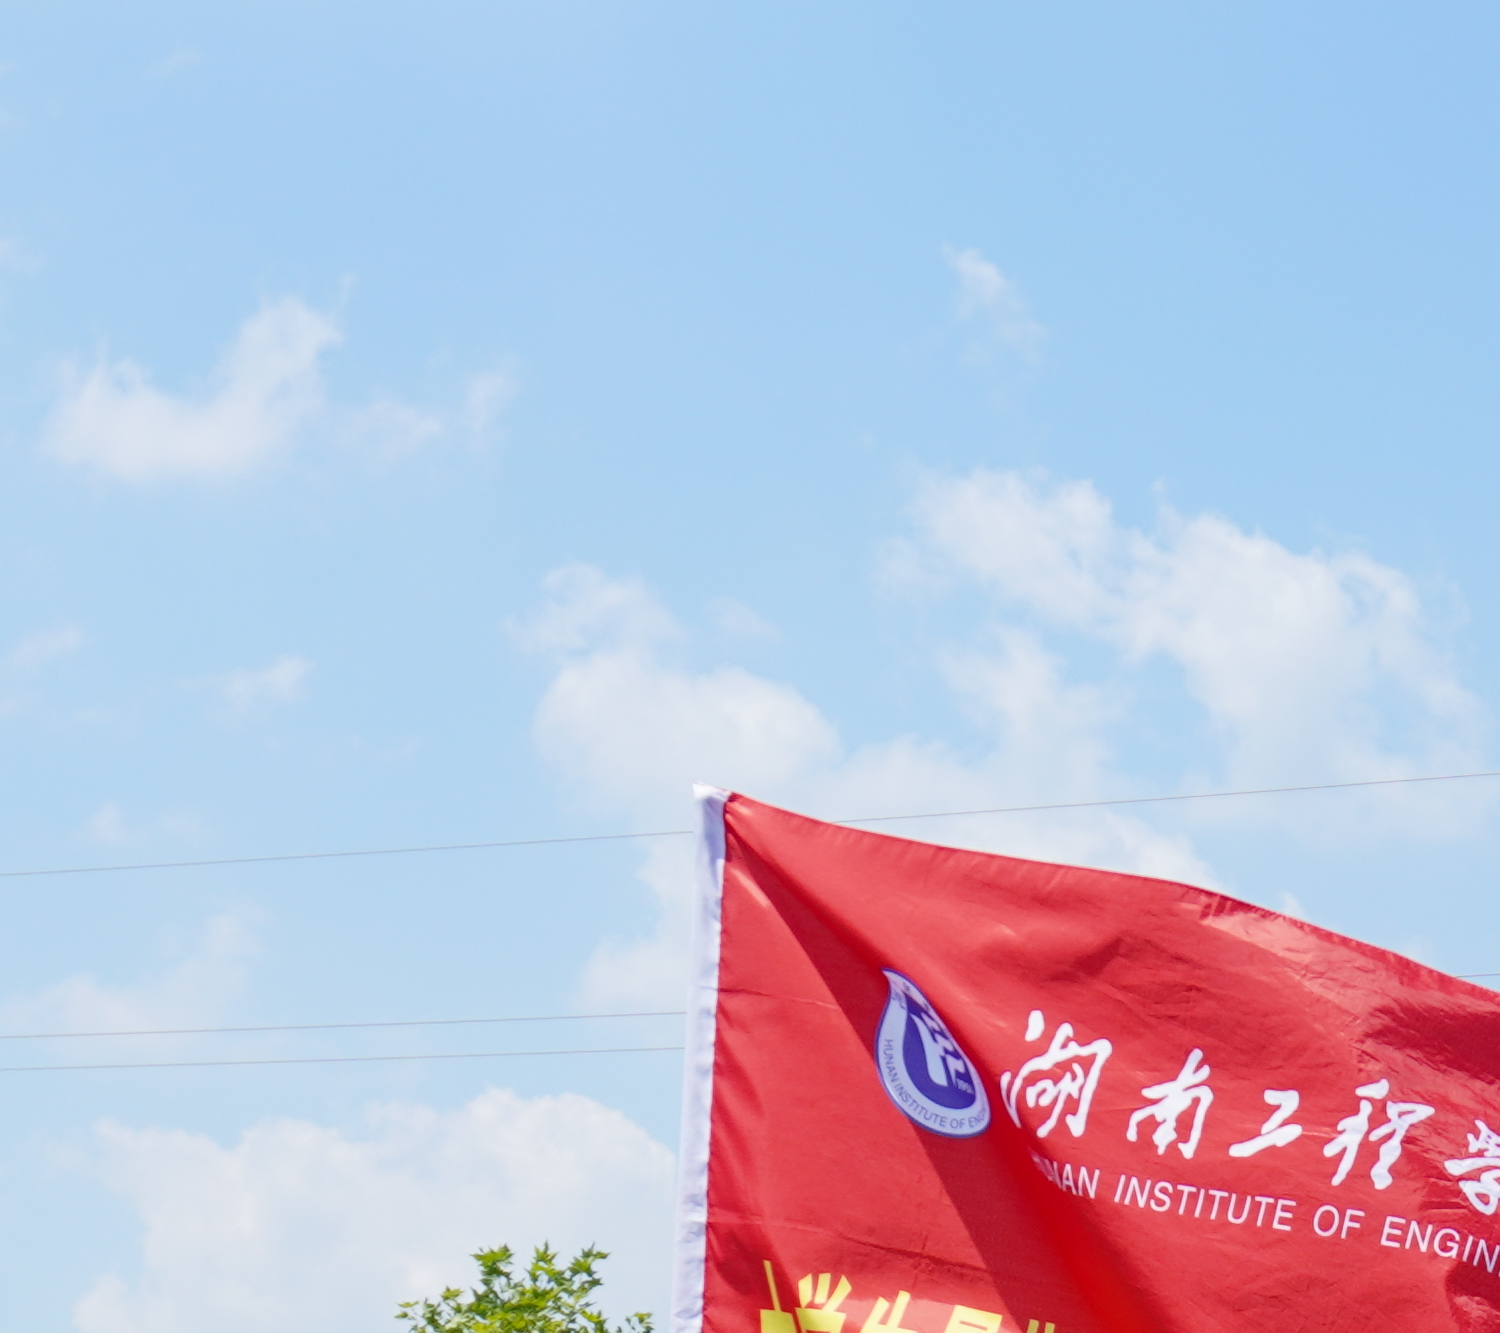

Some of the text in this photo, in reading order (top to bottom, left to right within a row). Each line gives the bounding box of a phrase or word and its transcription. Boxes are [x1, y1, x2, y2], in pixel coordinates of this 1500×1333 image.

[882, 1038, 898, 1082] HUNAN
[893, 1082, 948, 1128] INSTITUTE
[950, 1117, 965, 1129] OF
[1113, 1174, 1298, 1232] INSTITUTE
[1312, 1204, 1366, 1240] OF
